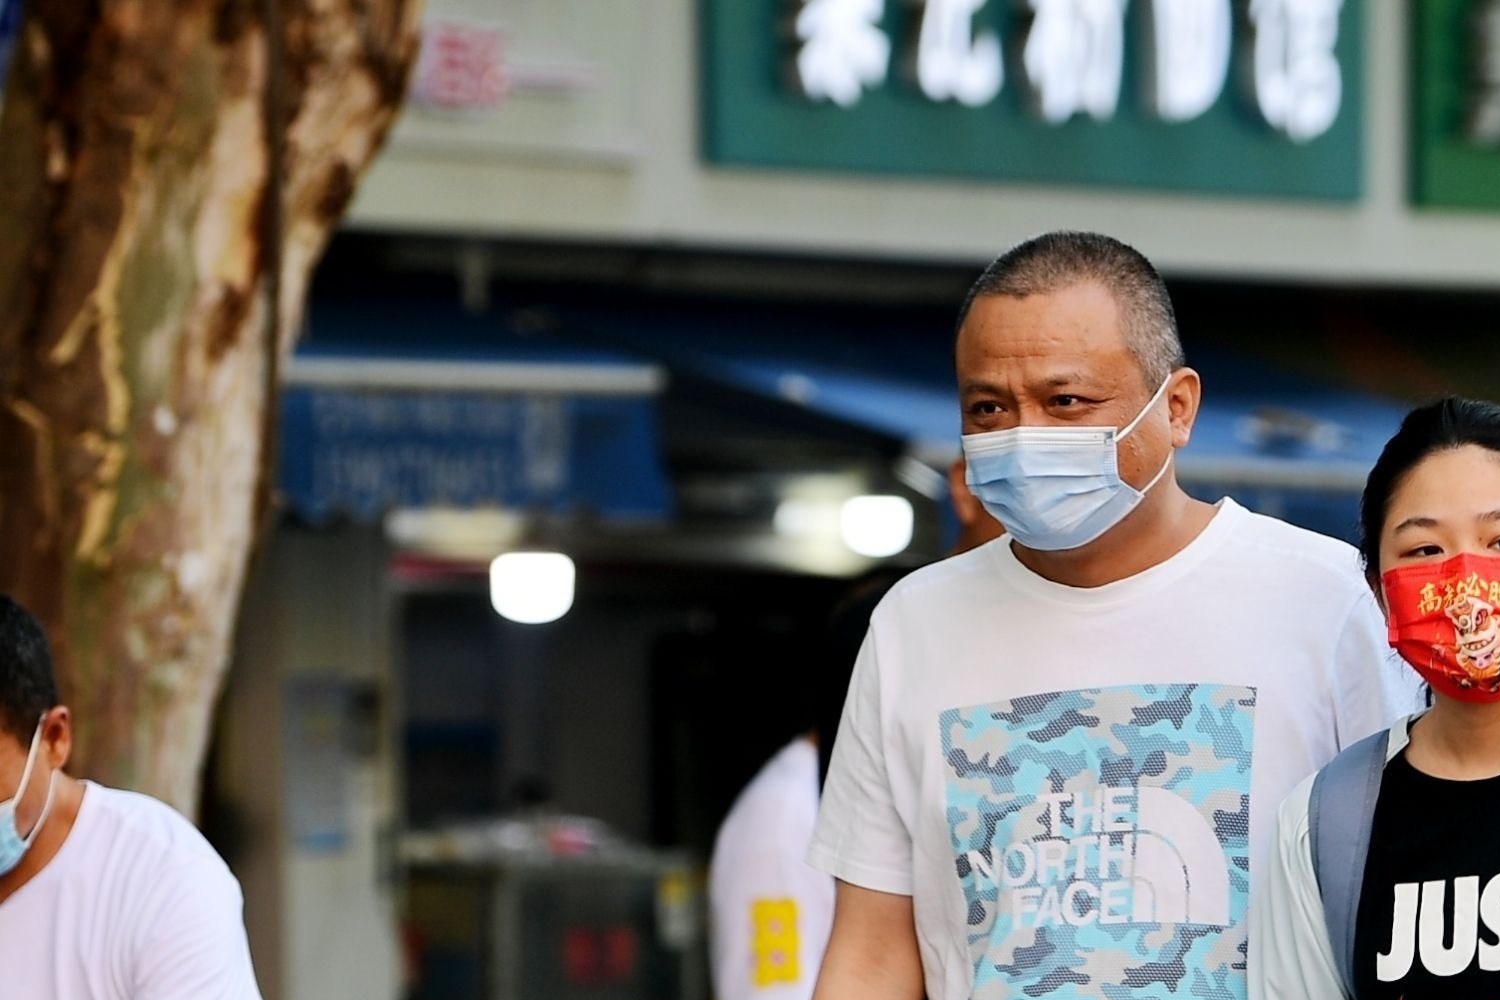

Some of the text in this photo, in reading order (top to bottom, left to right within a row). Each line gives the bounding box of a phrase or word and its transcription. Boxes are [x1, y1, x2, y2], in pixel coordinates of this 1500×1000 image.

[1036, 786, 1135, 838] THE
[968, 829, 1135, 892] NORTH
[1012, 878, 1134, 930] FACE
